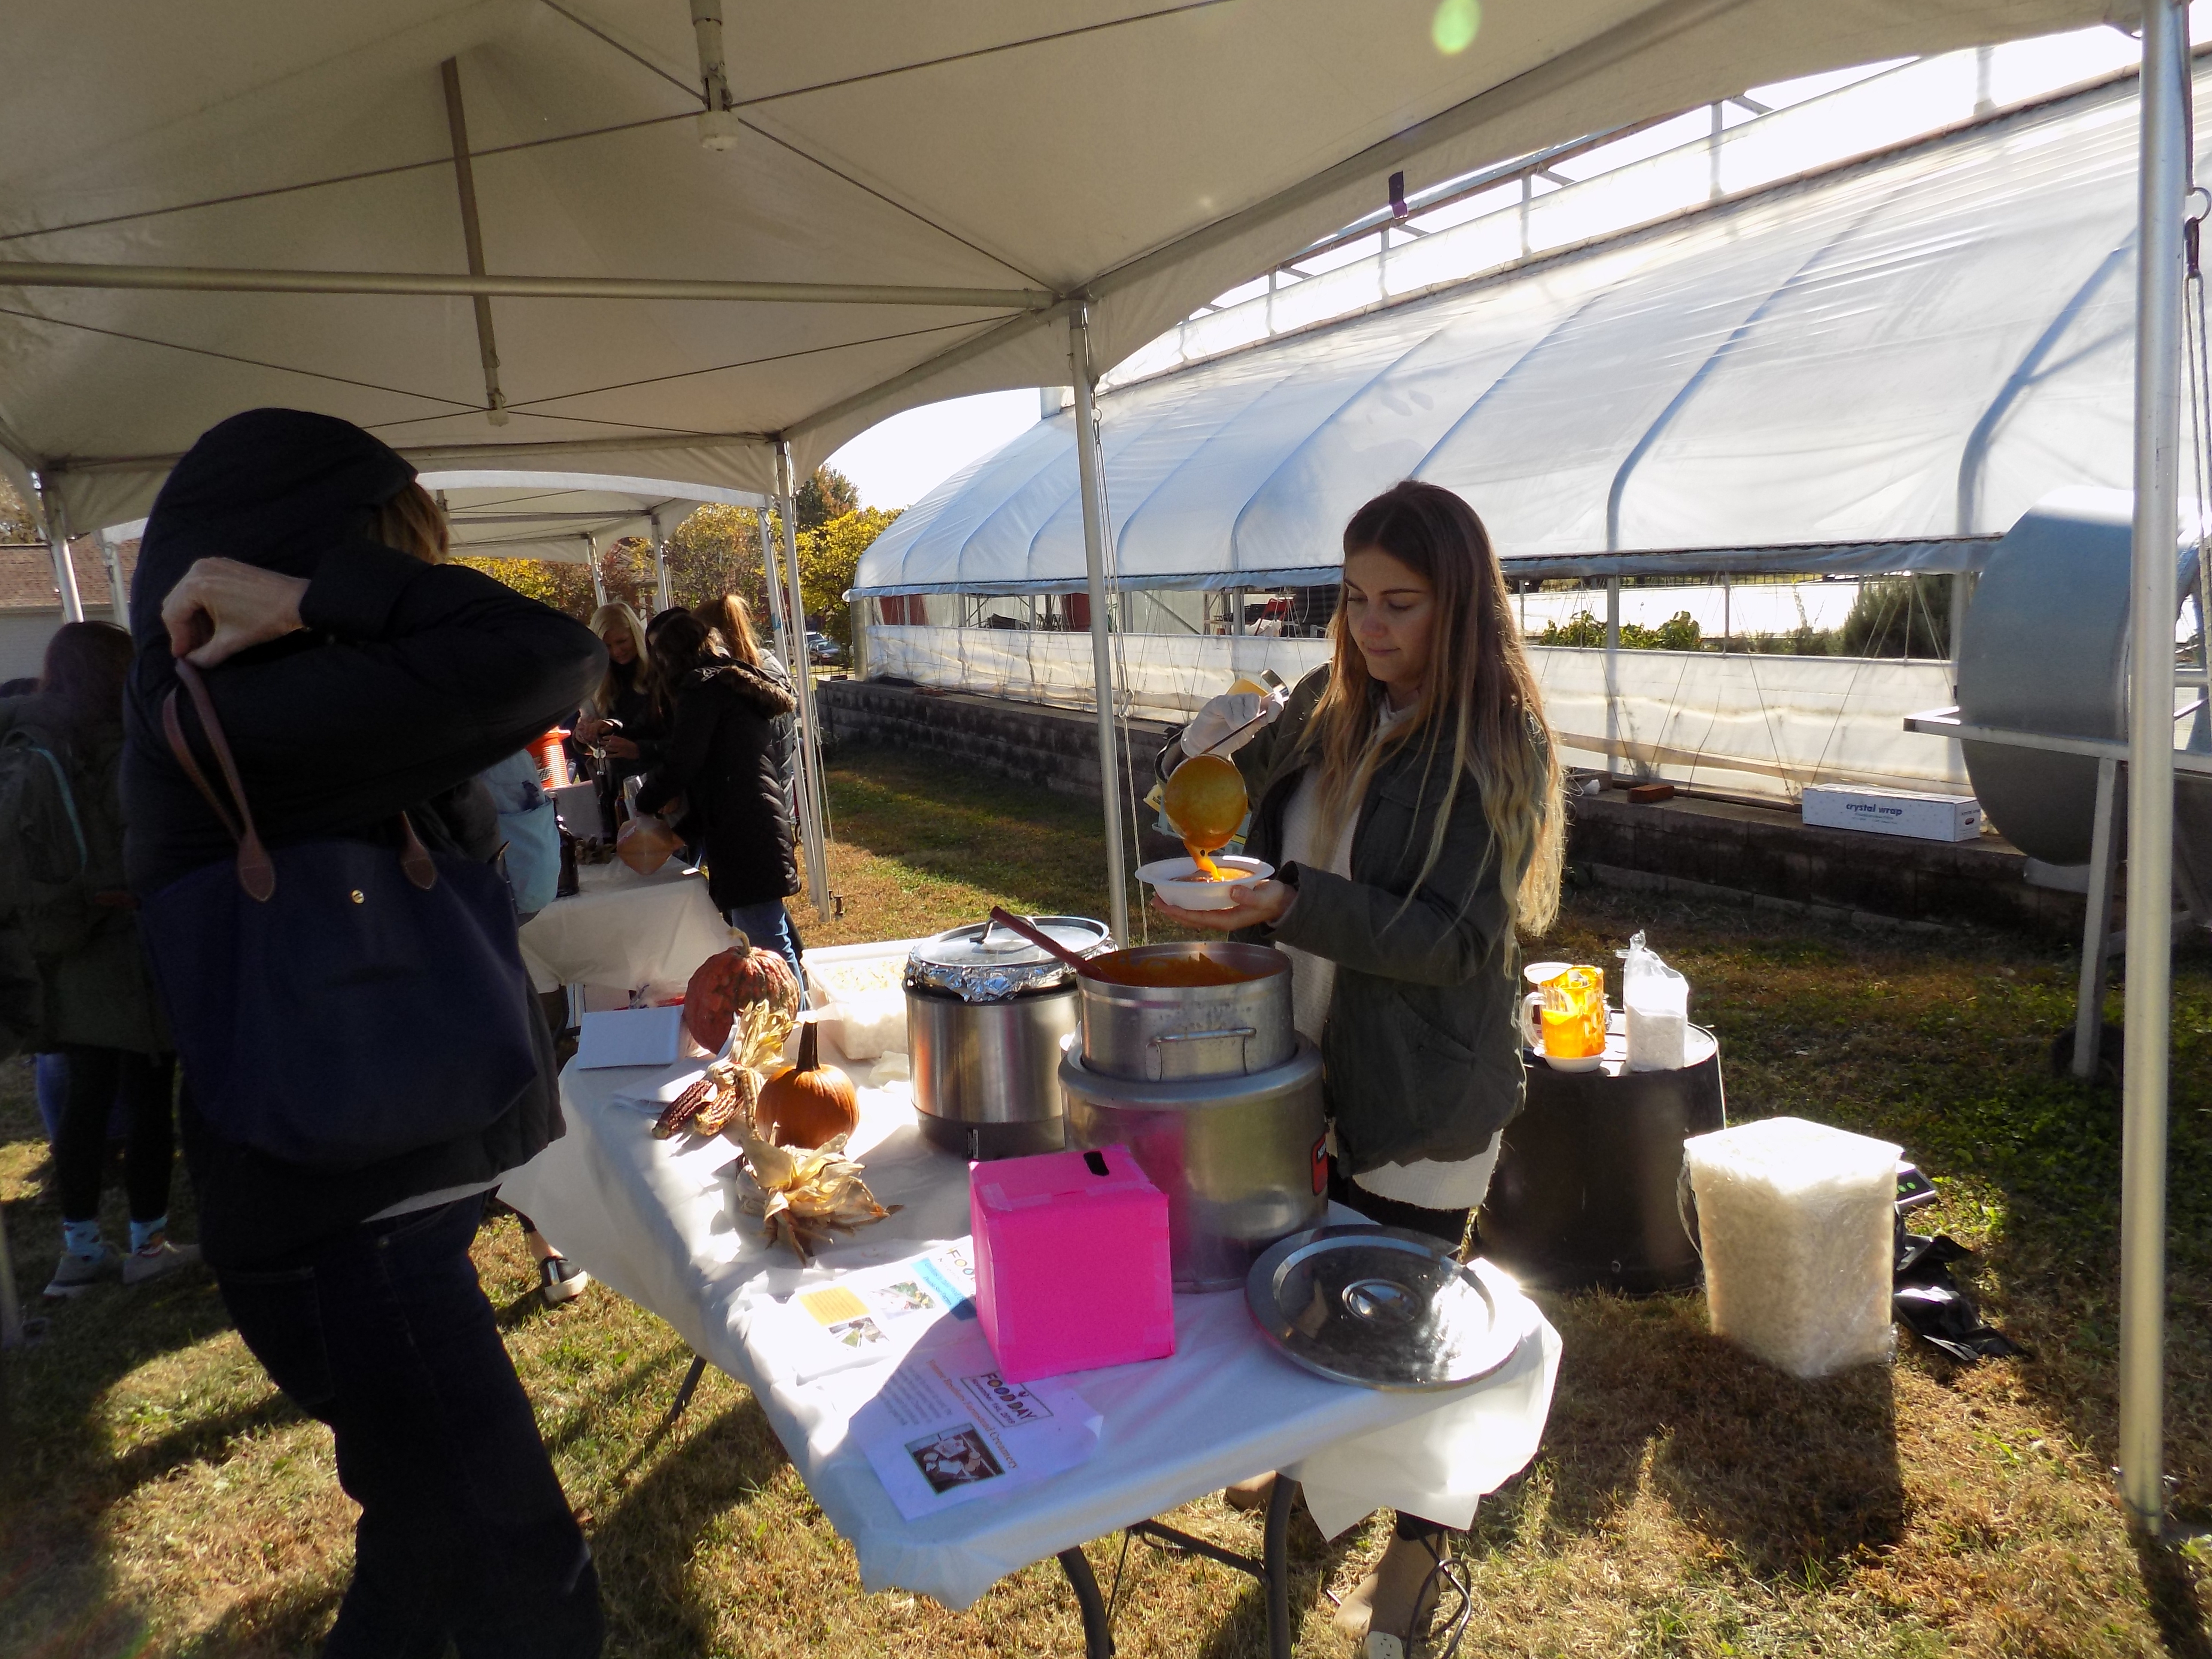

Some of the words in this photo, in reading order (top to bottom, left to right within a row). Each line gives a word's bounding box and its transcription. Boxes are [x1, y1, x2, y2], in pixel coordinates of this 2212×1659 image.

[1846, 804, 1876, 812] crystal
[1879, 807, 1902, 816] wrap
[946, 1249, 975, 1282] FOO
[981, 1373, 1016, 1401] FOOD
[1007, 1401, 1037, 1419] DAY
[990, 1432, 1017, 1468] Creamery
